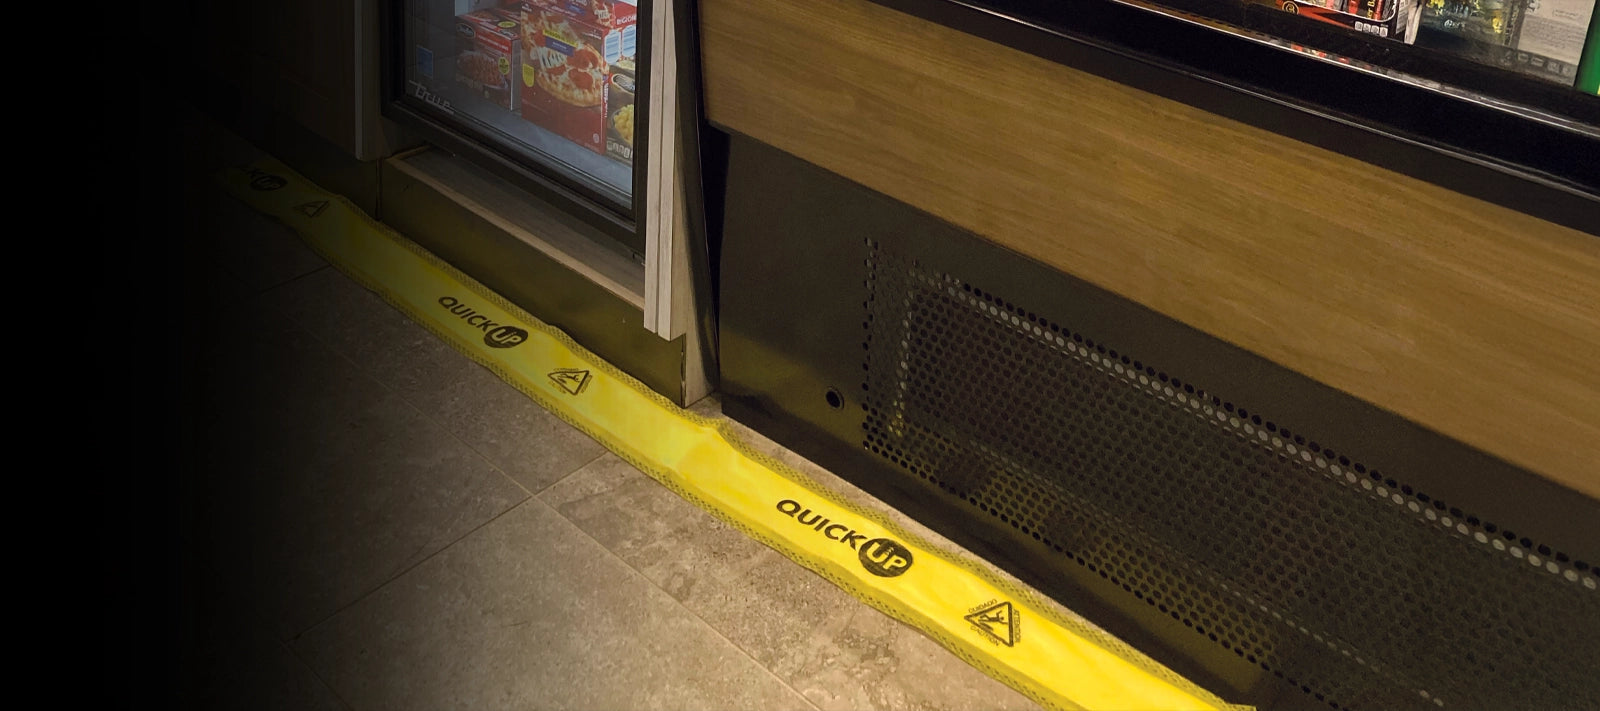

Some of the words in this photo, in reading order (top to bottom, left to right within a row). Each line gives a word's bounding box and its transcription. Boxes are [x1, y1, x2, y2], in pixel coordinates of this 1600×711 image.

[438, 296, 499, 332] QUICK
[490, 329, 523, 344] UP
[776, 499, 867, 551] QUICK
[866, 542, 908, 571] UP
[970, 625, 1000, 646] CAUTION
